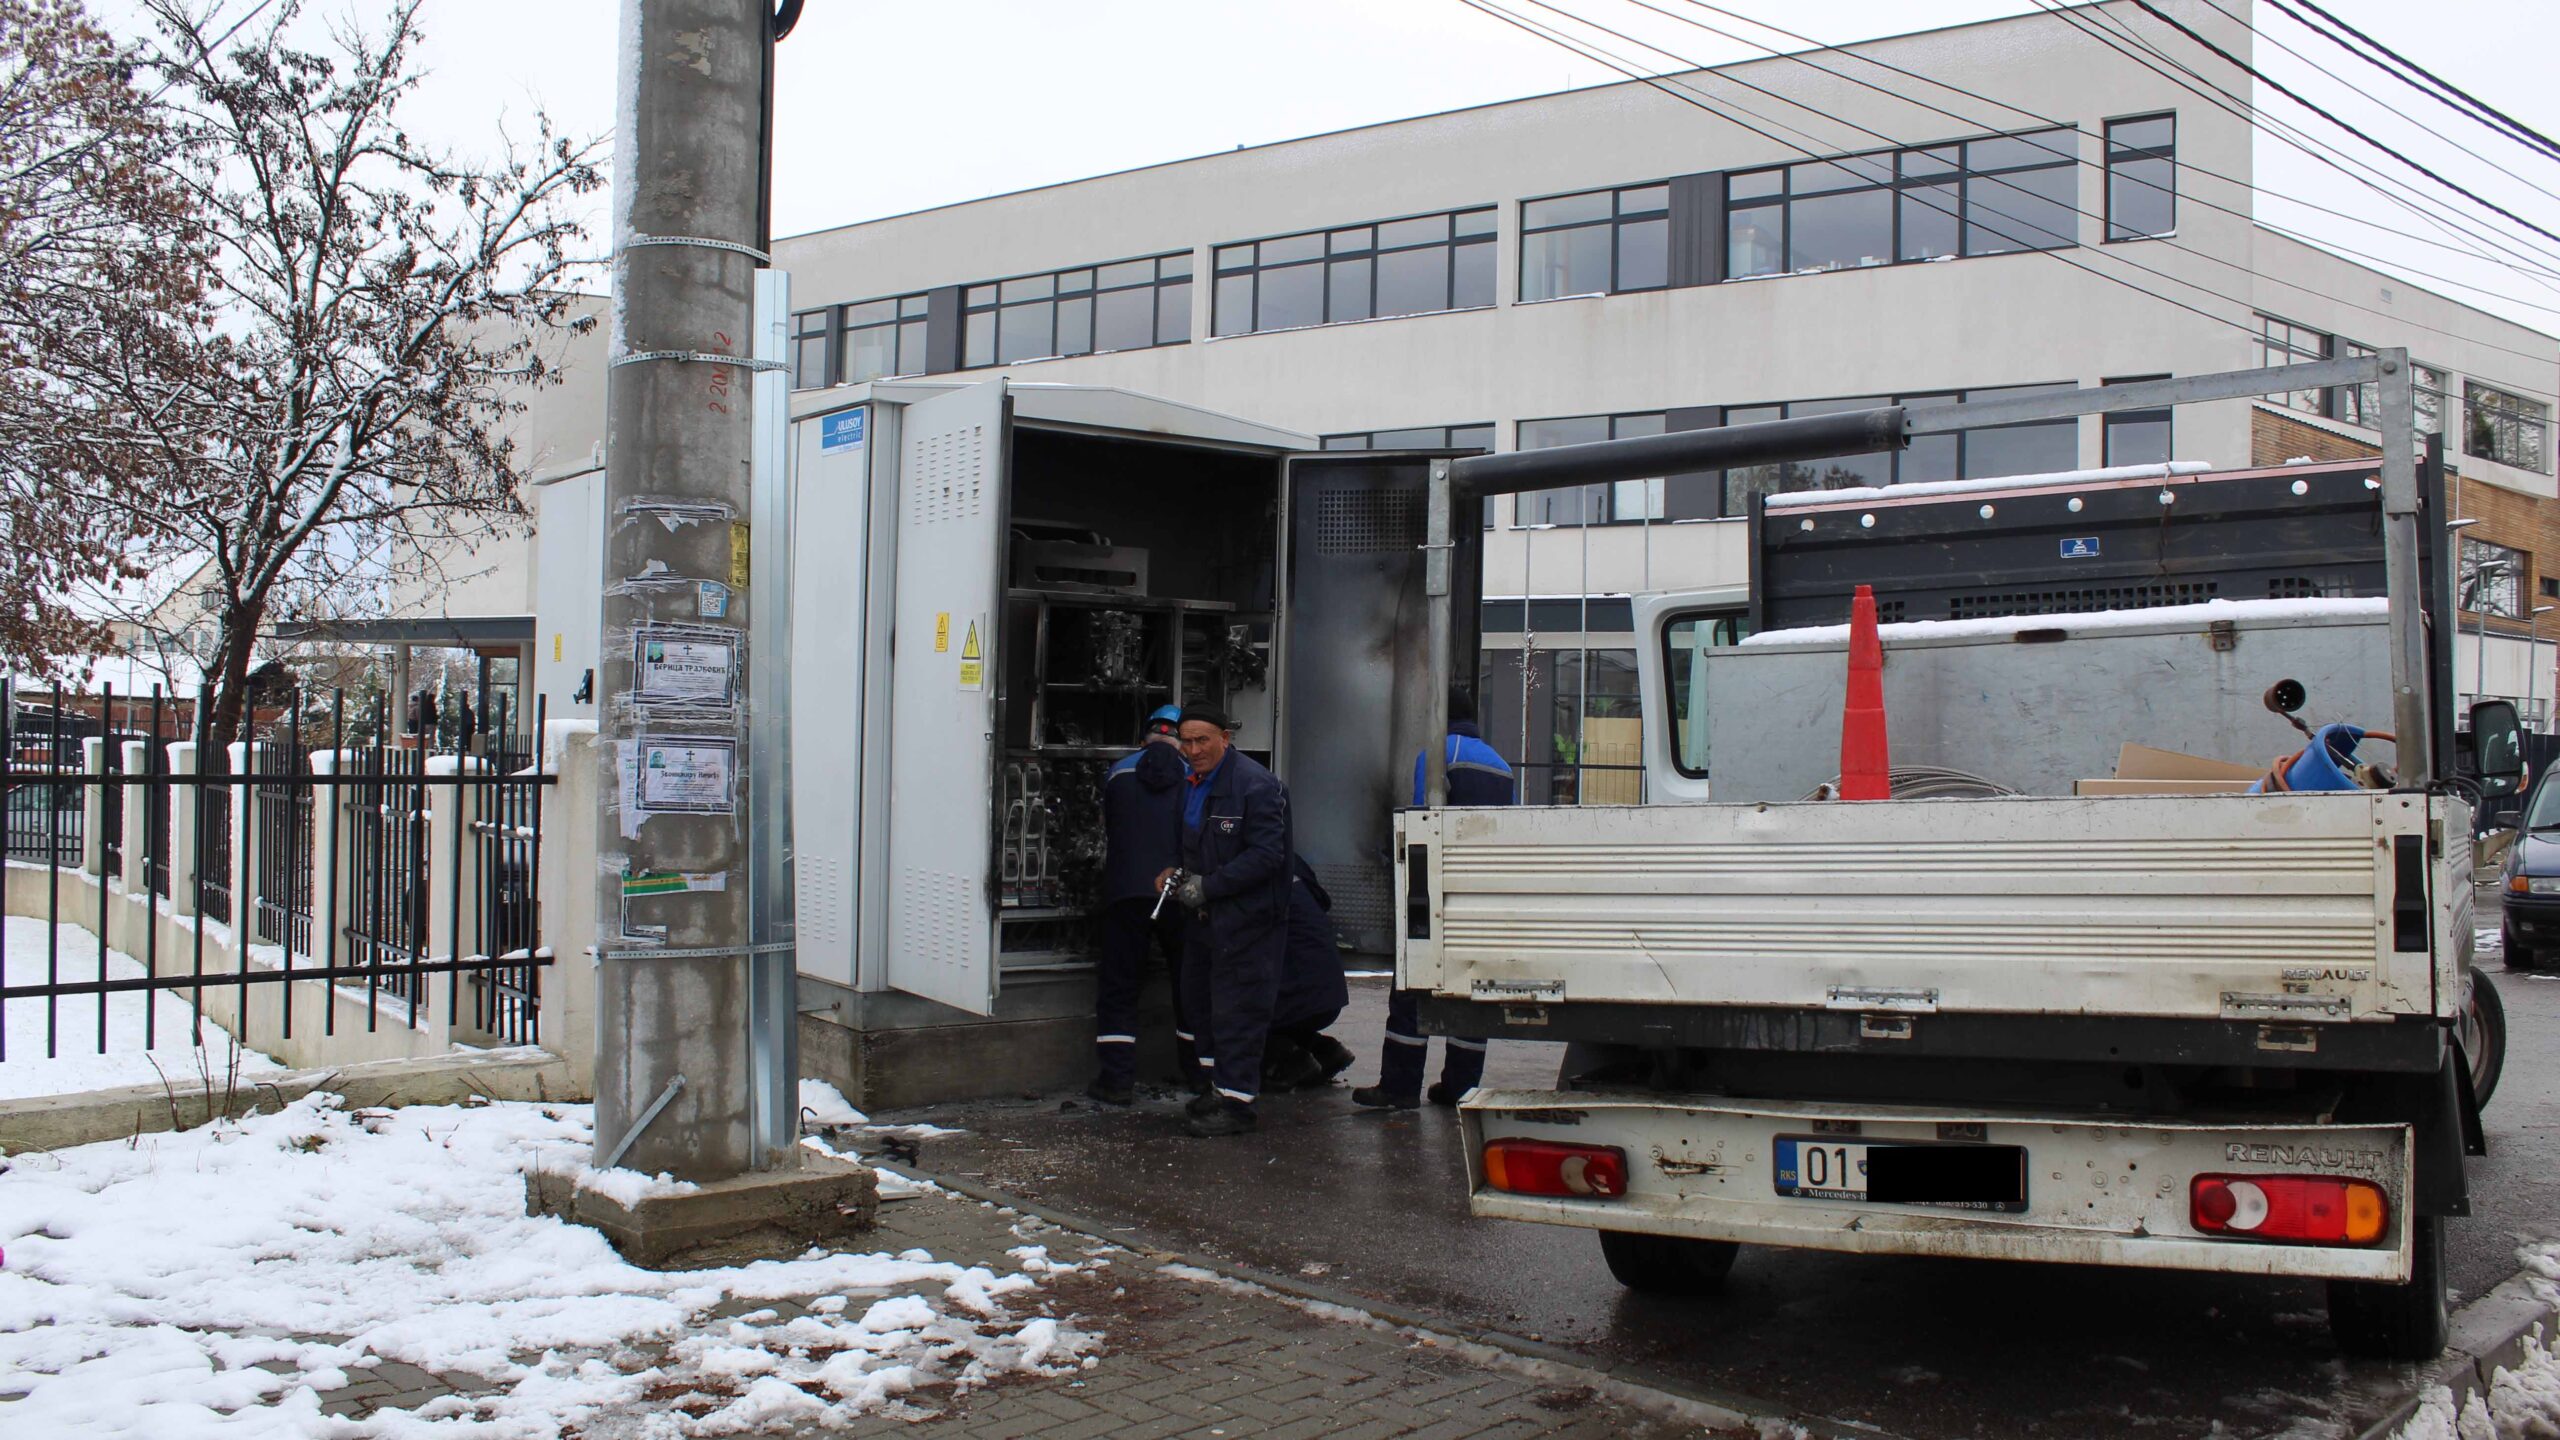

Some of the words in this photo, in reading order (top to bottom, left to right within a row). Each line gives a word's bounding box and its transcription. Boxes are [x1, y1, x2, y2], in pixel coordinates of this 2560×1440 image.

[2281, 967, 2370, 981] RENAULT
[2225, 1142, 2384, 1171] RENAULT
[1806, 1146, 1847, 1188] 01
[1780, 1169, 1797, 1182] RKS
[1808, 1188, 1867, 1201] Mercedes-B
